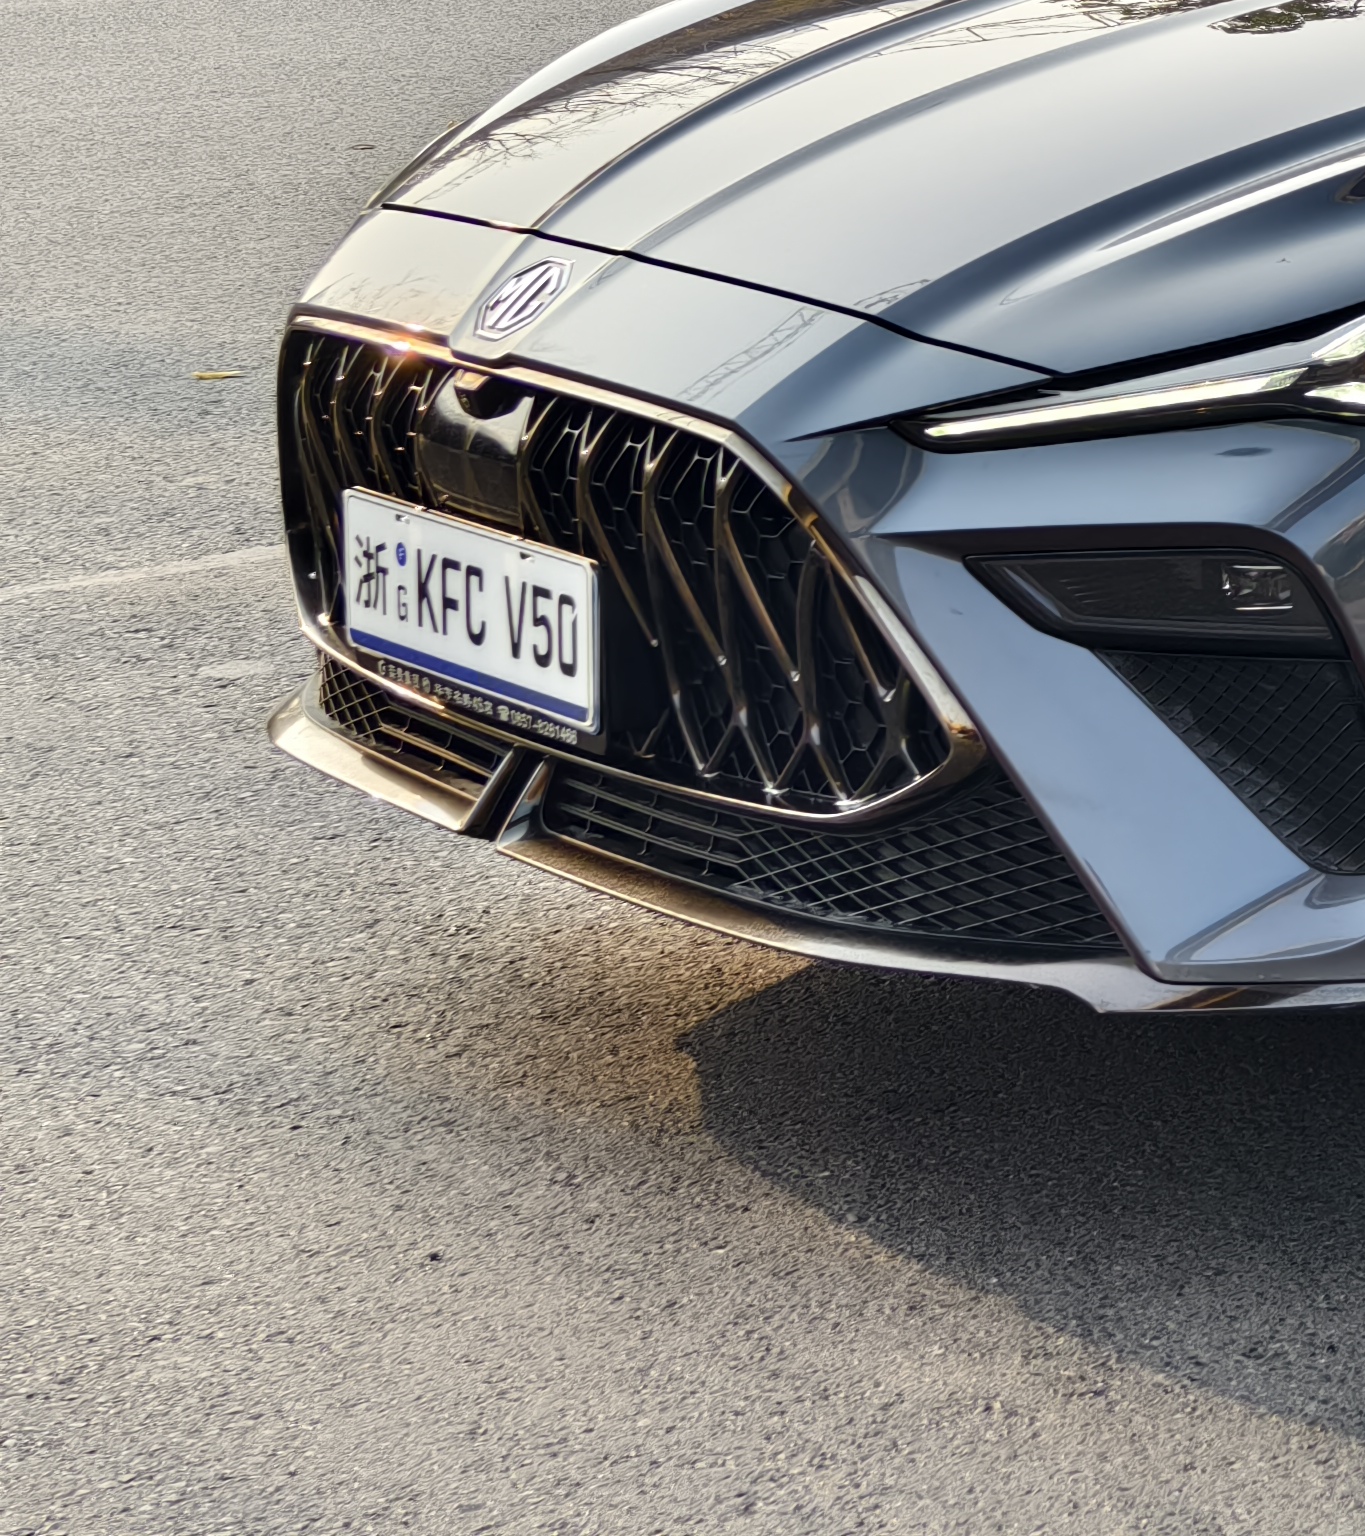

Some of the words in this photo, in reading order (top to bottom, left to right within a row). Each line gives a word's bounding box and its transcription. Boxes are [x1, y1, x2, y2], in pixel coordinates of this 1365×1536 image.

[485, 263, 564, 332] MG
[354, 533, 390, 616] 浙
[416, 547, 487, 647] KFC
[504, 574, 579, 678] V50
